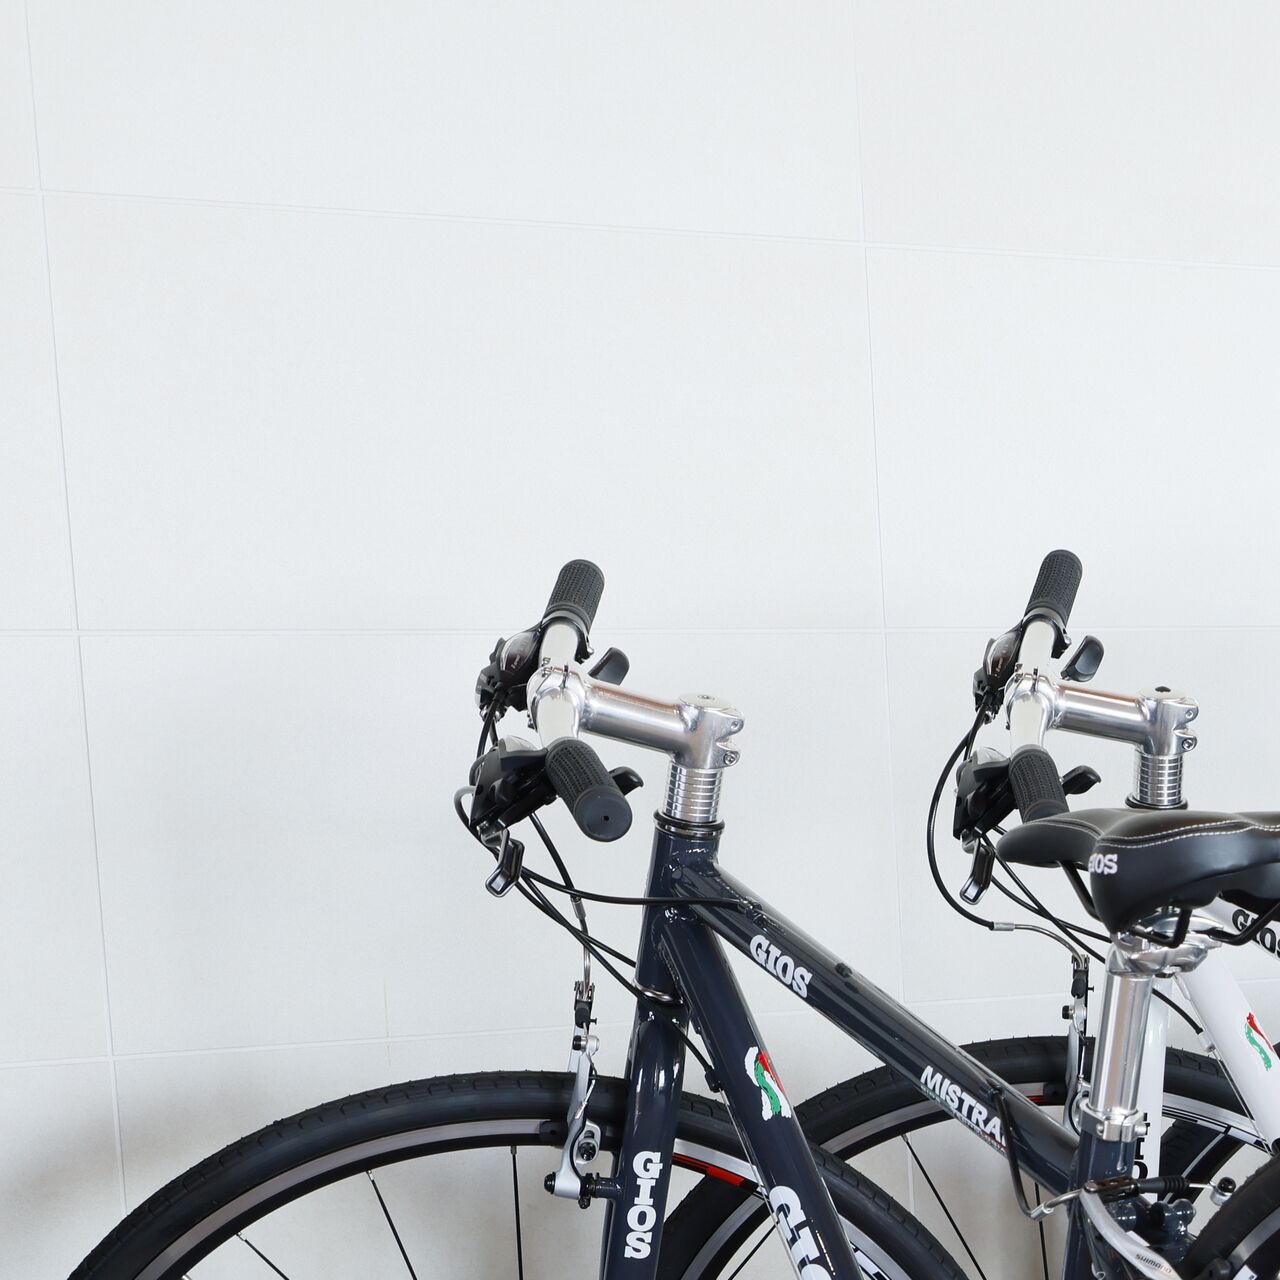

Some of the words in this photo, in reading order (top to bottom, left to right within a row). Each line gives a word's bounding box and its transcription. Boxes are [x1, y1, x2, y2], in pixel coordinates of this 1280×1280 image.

[750, 935, 813, 998] GIOS
[920, 1065, 1008, 1146] MISTRA
[624, 1151, 663, 1259] GIOS
